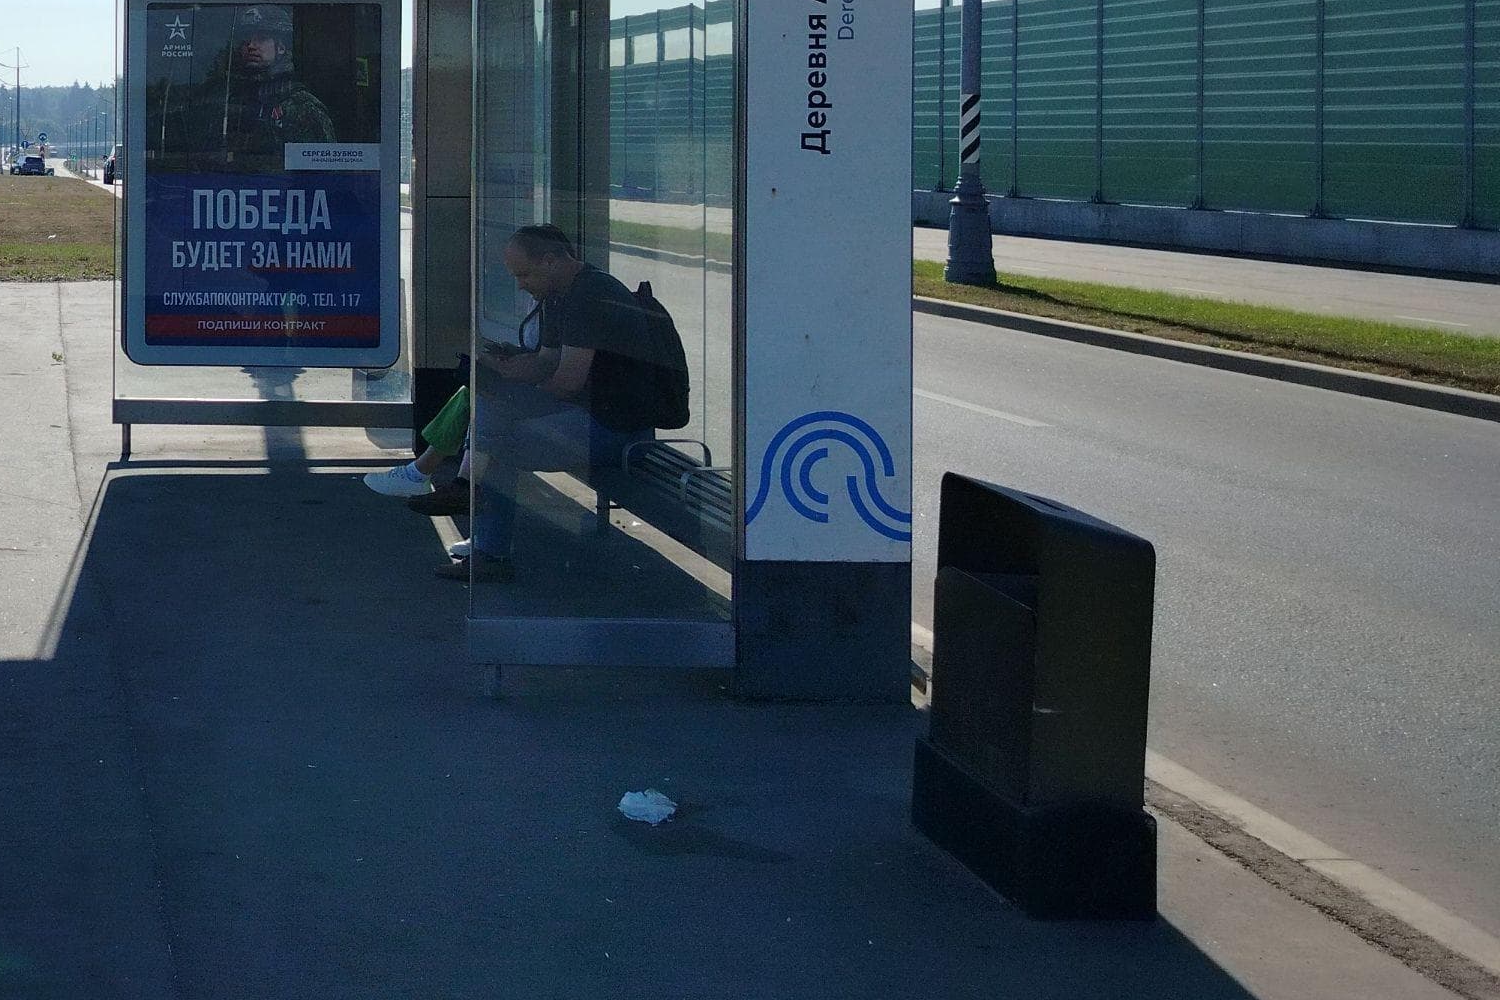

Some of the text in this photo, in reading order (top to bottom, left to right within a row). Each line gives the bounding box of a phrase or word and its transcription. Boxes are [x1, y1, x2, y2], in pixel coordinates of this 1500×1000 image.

[800, 13, 833, 155] Деревня
[302, 149, 331, 157] СЕРГЕЙ
[192, 189, 332, 235] ПОБЕДА
[172, 241, 352, 271] БУДЕТ ЗА НАМИ
[163, 291, 361, 307] СЛУЖБАПОКОНТРАКТУ.РФ, ТЕЛ. 117
[197, 320, 326, 331] ПОДПИШИ КОНТРАКТ
